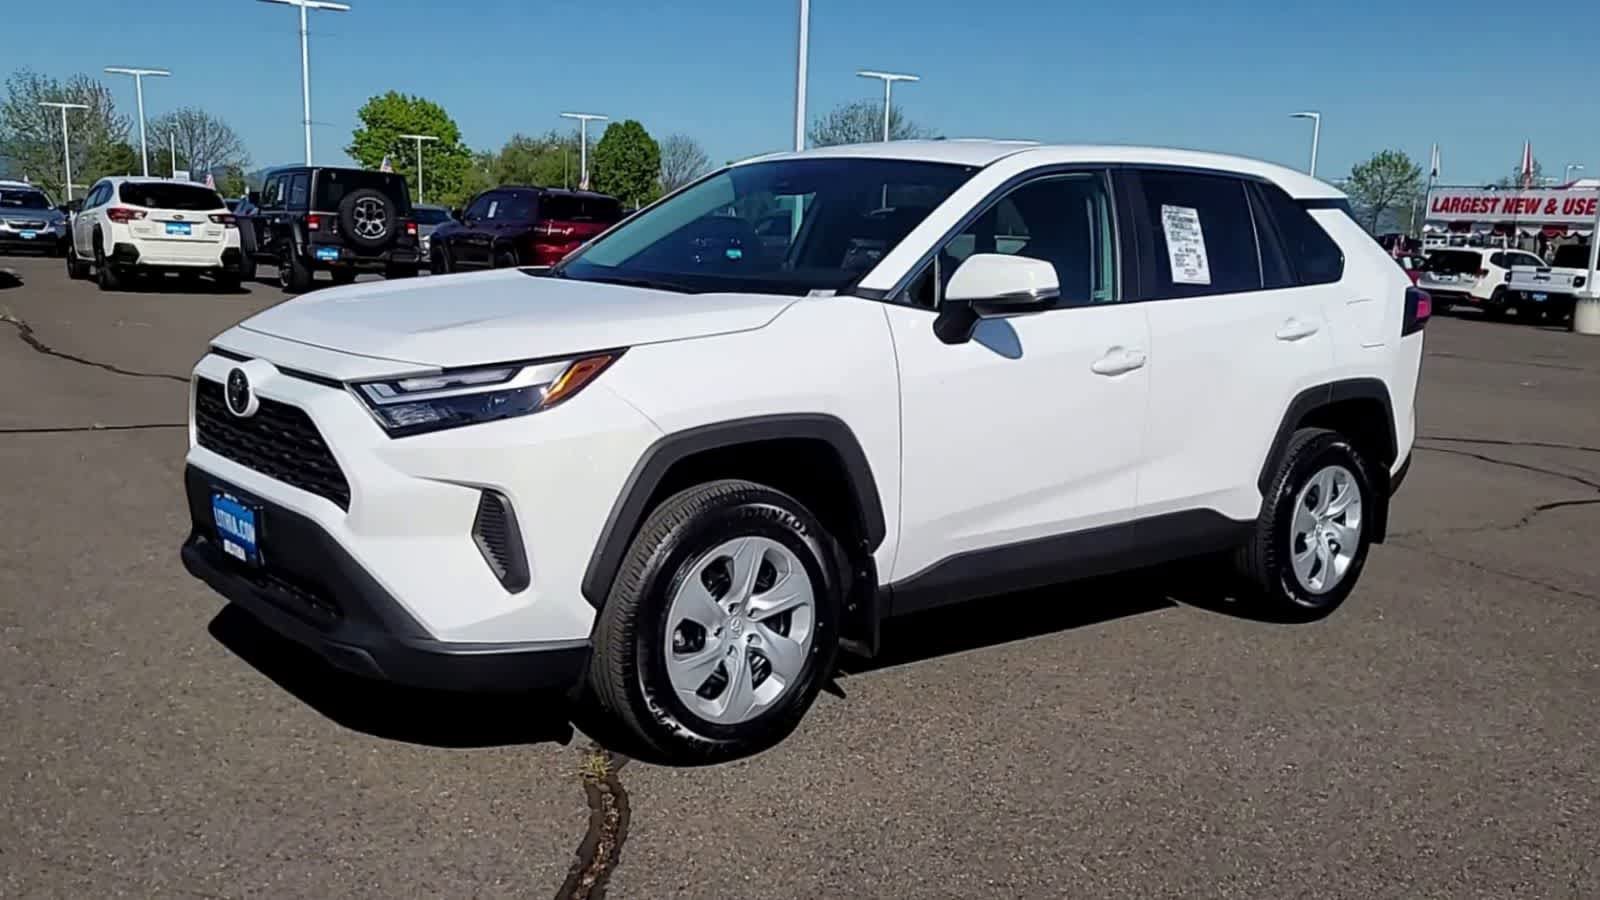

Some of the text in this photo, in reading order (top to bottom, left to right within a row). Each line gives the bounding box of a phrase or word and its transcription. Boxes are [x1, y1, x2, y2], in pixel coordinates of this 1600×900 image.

[1431, 197, 1500, 213] LARGEST
[1502, 197, 1543, 215] NEW
[1544, 198, 1558, 215] &
